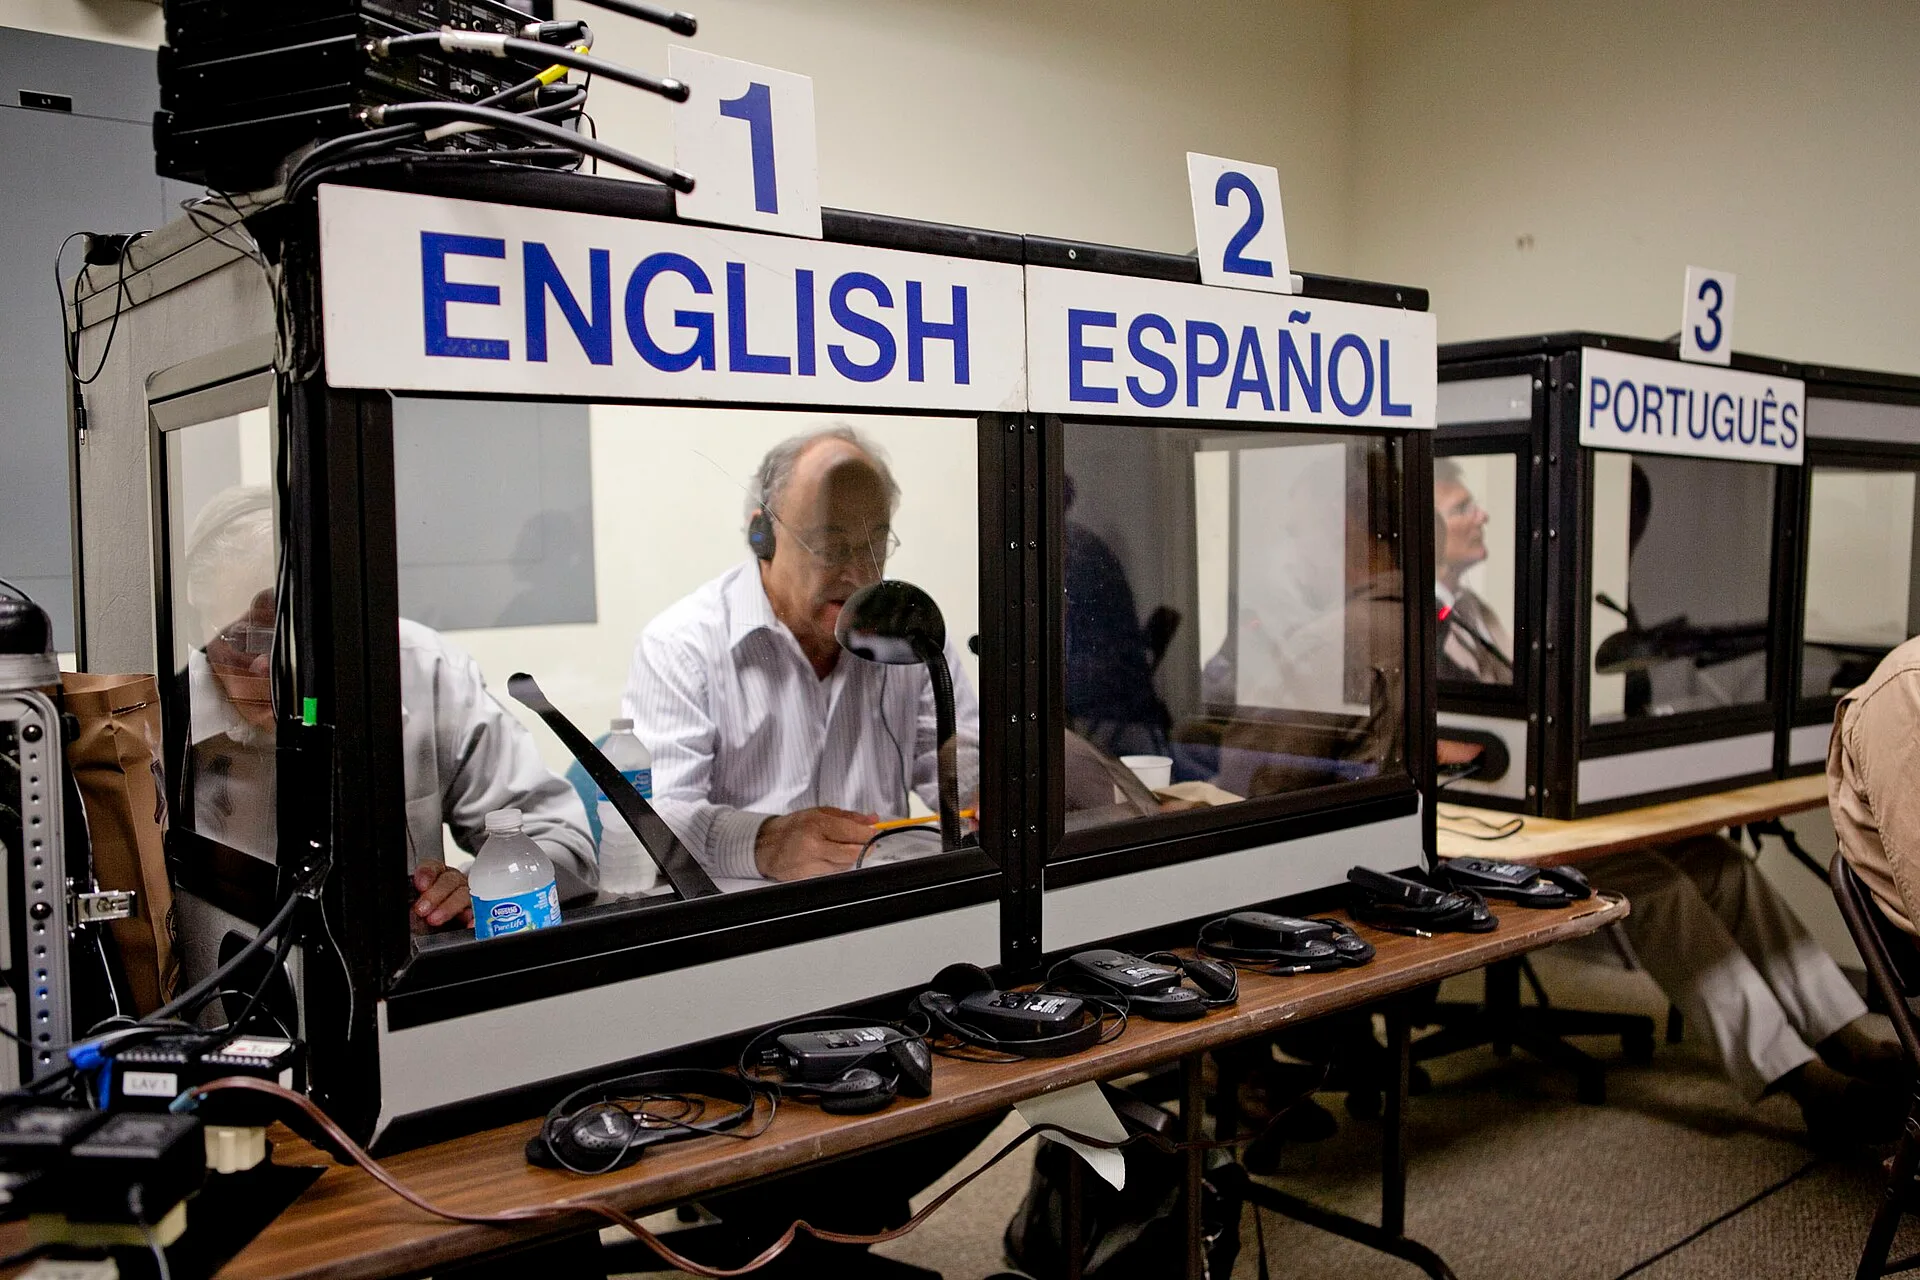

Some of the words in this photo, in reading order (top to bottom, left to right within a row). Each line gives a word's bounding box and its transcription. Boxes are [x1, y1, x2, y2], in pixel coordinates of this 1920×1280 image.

[719, 82, 779, 215] 1
[1214, 171, 1274, 278] 2
[420, 230, 970, 385] ENGLISH
[1694, 278, 1724, 352] 3
[1067, 308, 1413, 417] ESPAÑOL
[1589, 376, 1799, 449] PORTUGUÊS
[494, 921, 510, 932] Pure
[510, 918, 524, 929] Life
